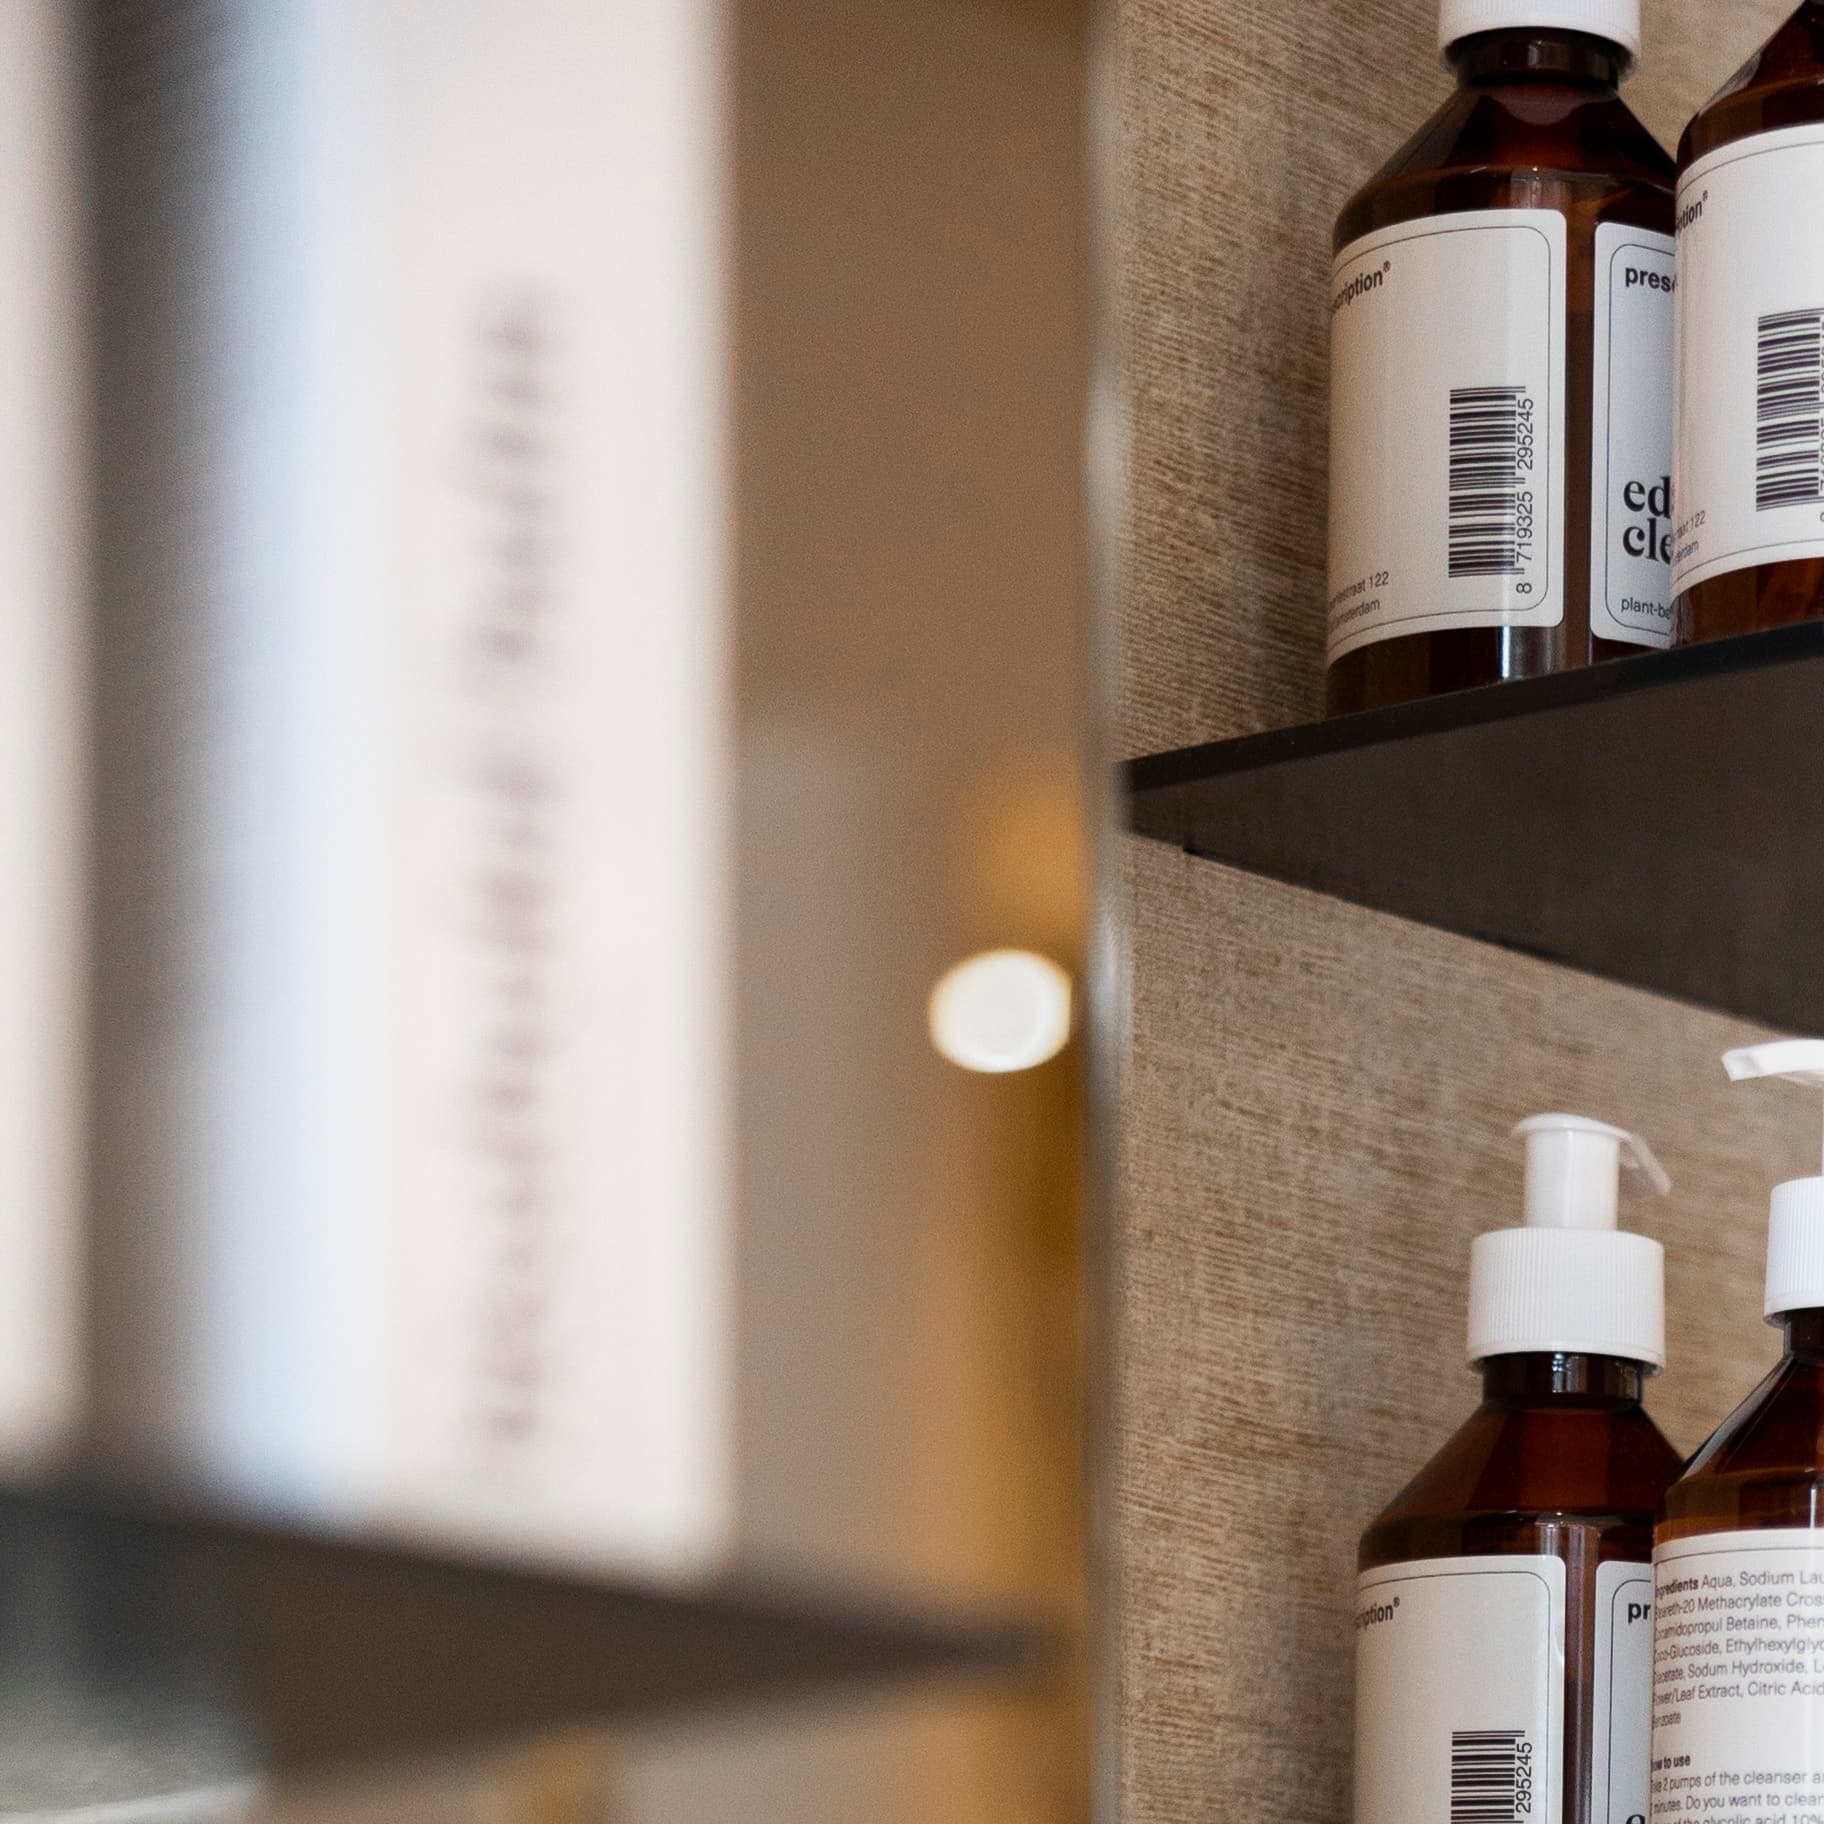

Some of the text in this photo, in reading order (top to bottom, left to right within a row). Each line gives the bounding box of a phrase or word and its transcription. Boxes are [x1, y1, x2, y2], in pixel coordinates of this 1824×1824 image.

[1515, 397, 1535, 594] 8 719325 295245
[1739, 1571, 1795, 1586] Sodium
[1515, 1741, 1532, 1814] 295245
